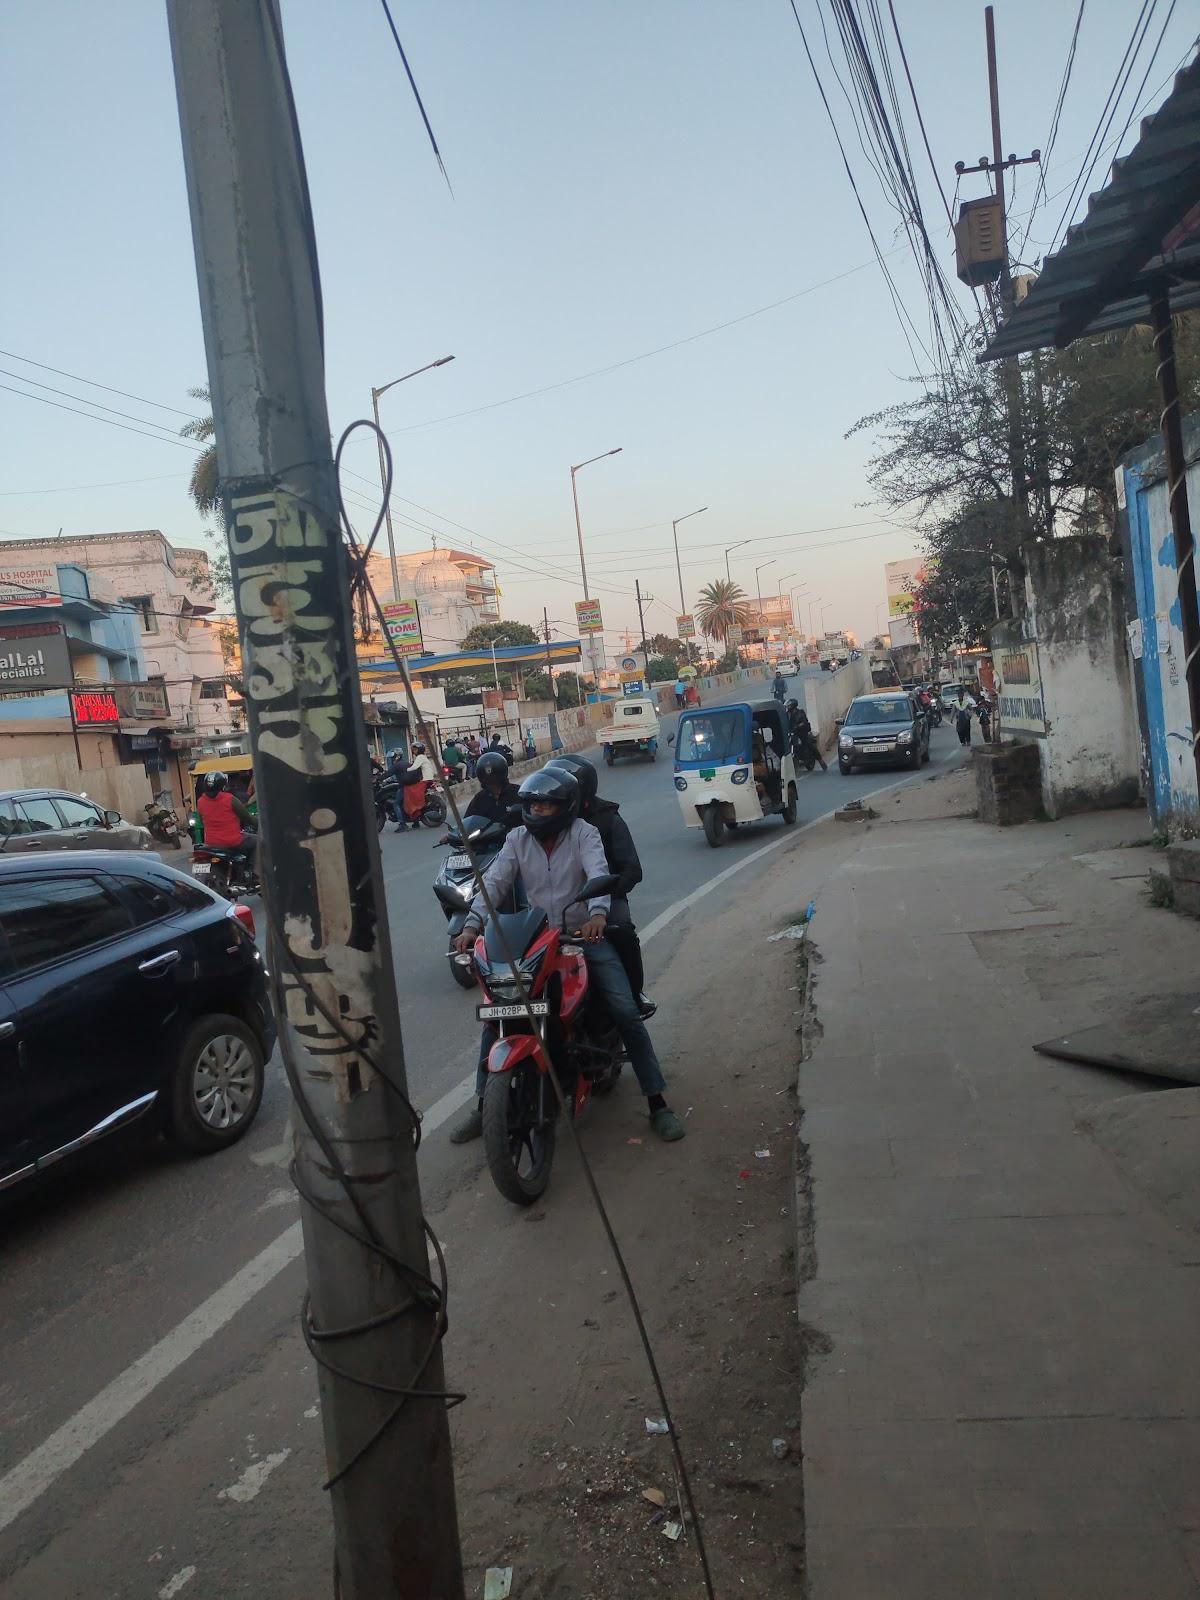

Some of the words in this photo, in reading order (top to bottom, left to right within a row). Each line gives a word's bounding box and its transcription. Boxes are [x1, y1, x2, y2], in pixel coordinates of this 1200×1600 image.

[13, 569, 53, 579] HOSPITAL
[388, 623, 417, 634] IOME
[16, 649, 44, 667] Lal
